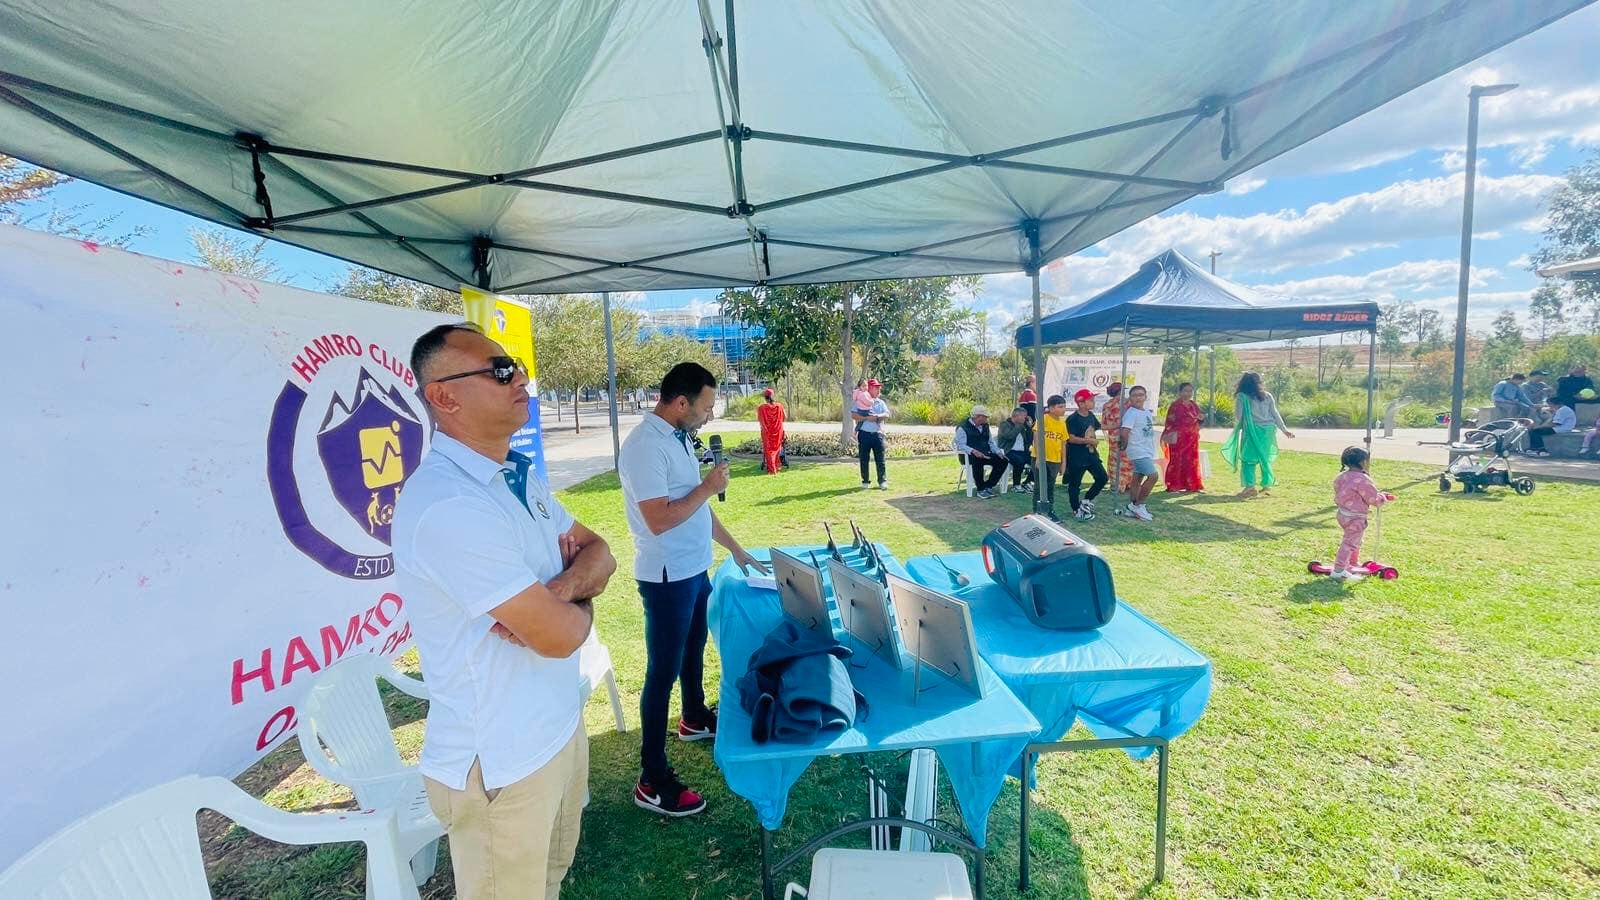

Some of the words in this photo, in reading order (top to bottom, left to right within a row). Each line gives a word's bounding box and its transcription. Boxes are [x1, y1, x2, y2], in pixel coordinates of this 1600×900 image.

[1303, 313, 1333, 321] RIDGE
[1334, 312, 1369, 321] RYDER
[291, 333, 363, 384] HAMRO
[368, 343, 414, 388] CLUB
[354, 556, 393, 576] ESTD.
